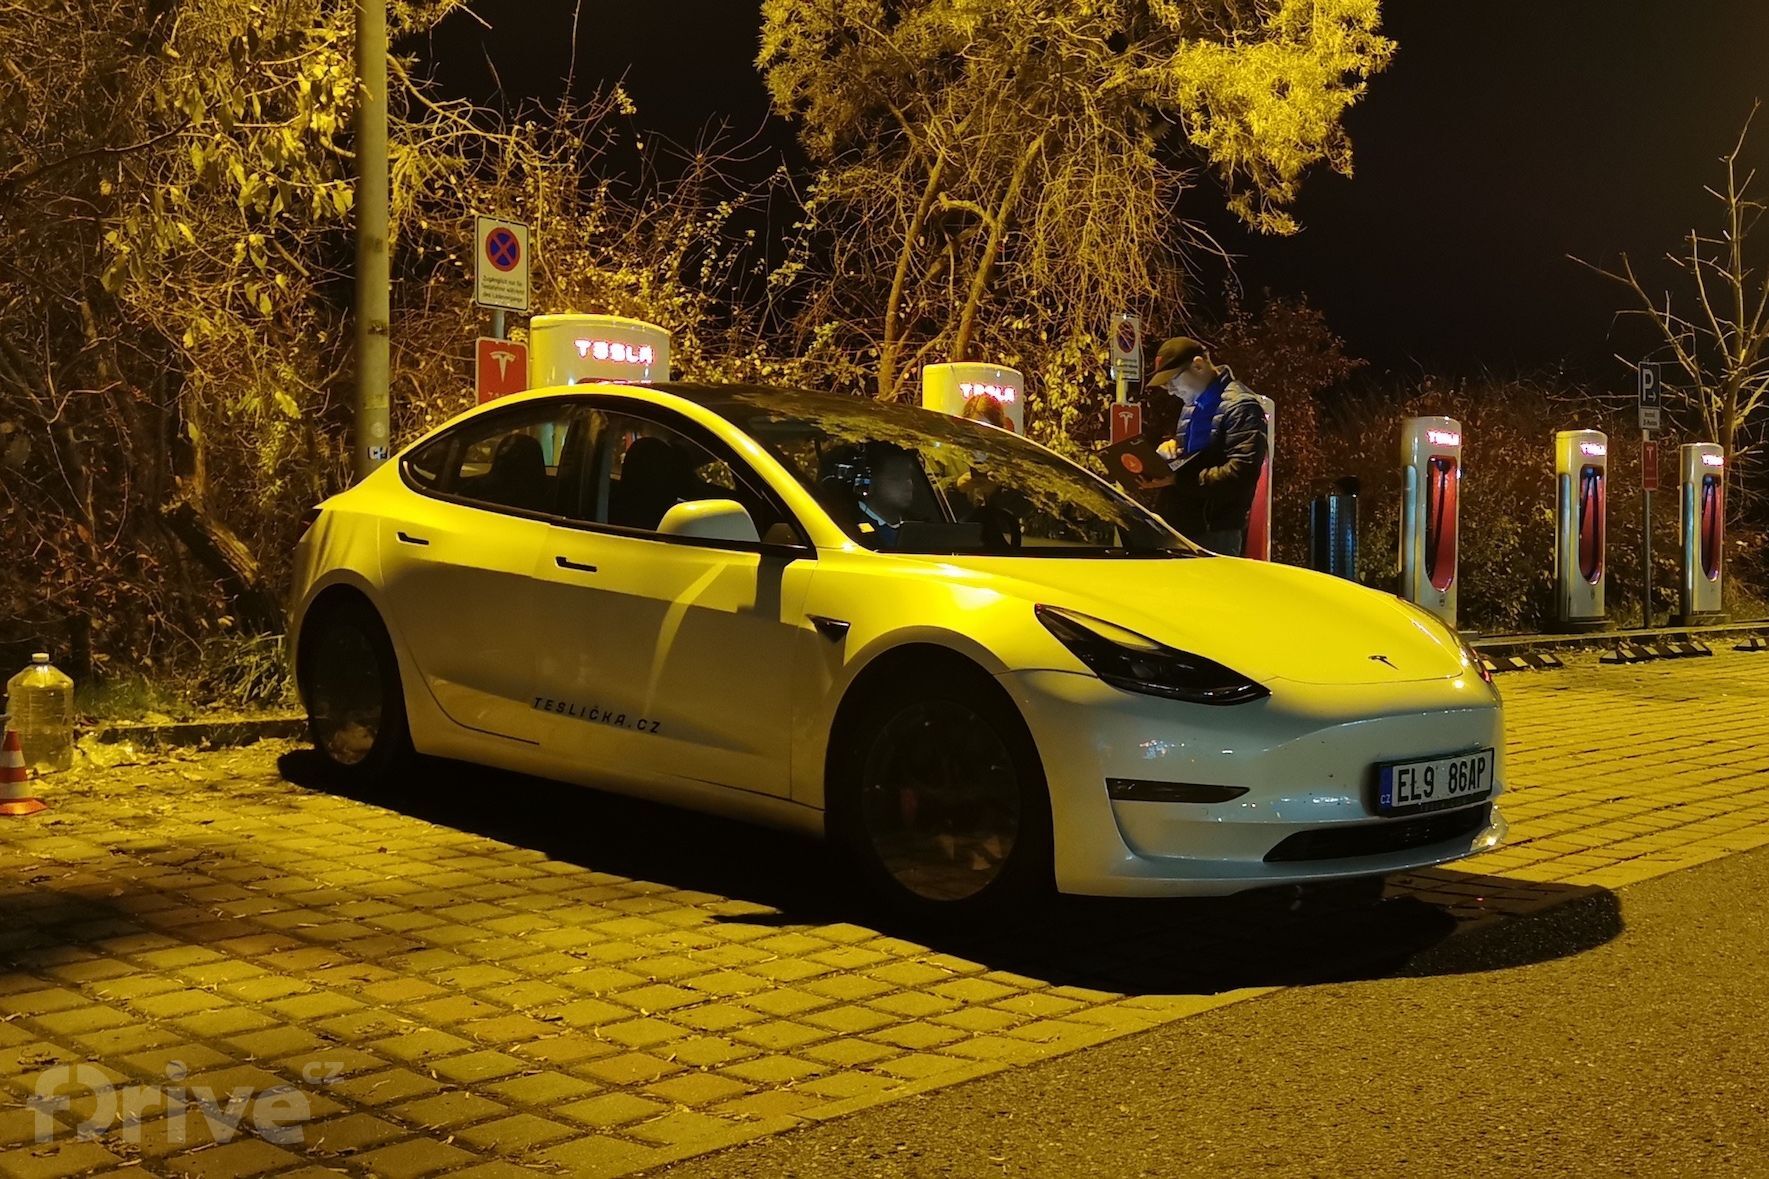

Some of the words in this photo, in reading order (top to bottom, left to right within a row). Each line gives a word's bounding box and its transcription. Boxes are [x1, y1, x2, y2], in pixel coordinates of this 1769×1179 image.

[575, 339, 654, 364] TESLA
[1642, 368, 1654, 402] P
[534, 697, 661, 734] TESLIČKA.CZ
[1397, 766, 1435, 803] EL9
[1448, 756, 1486, 794] 86AP
[1379, 794, 1391, 805] CZ
